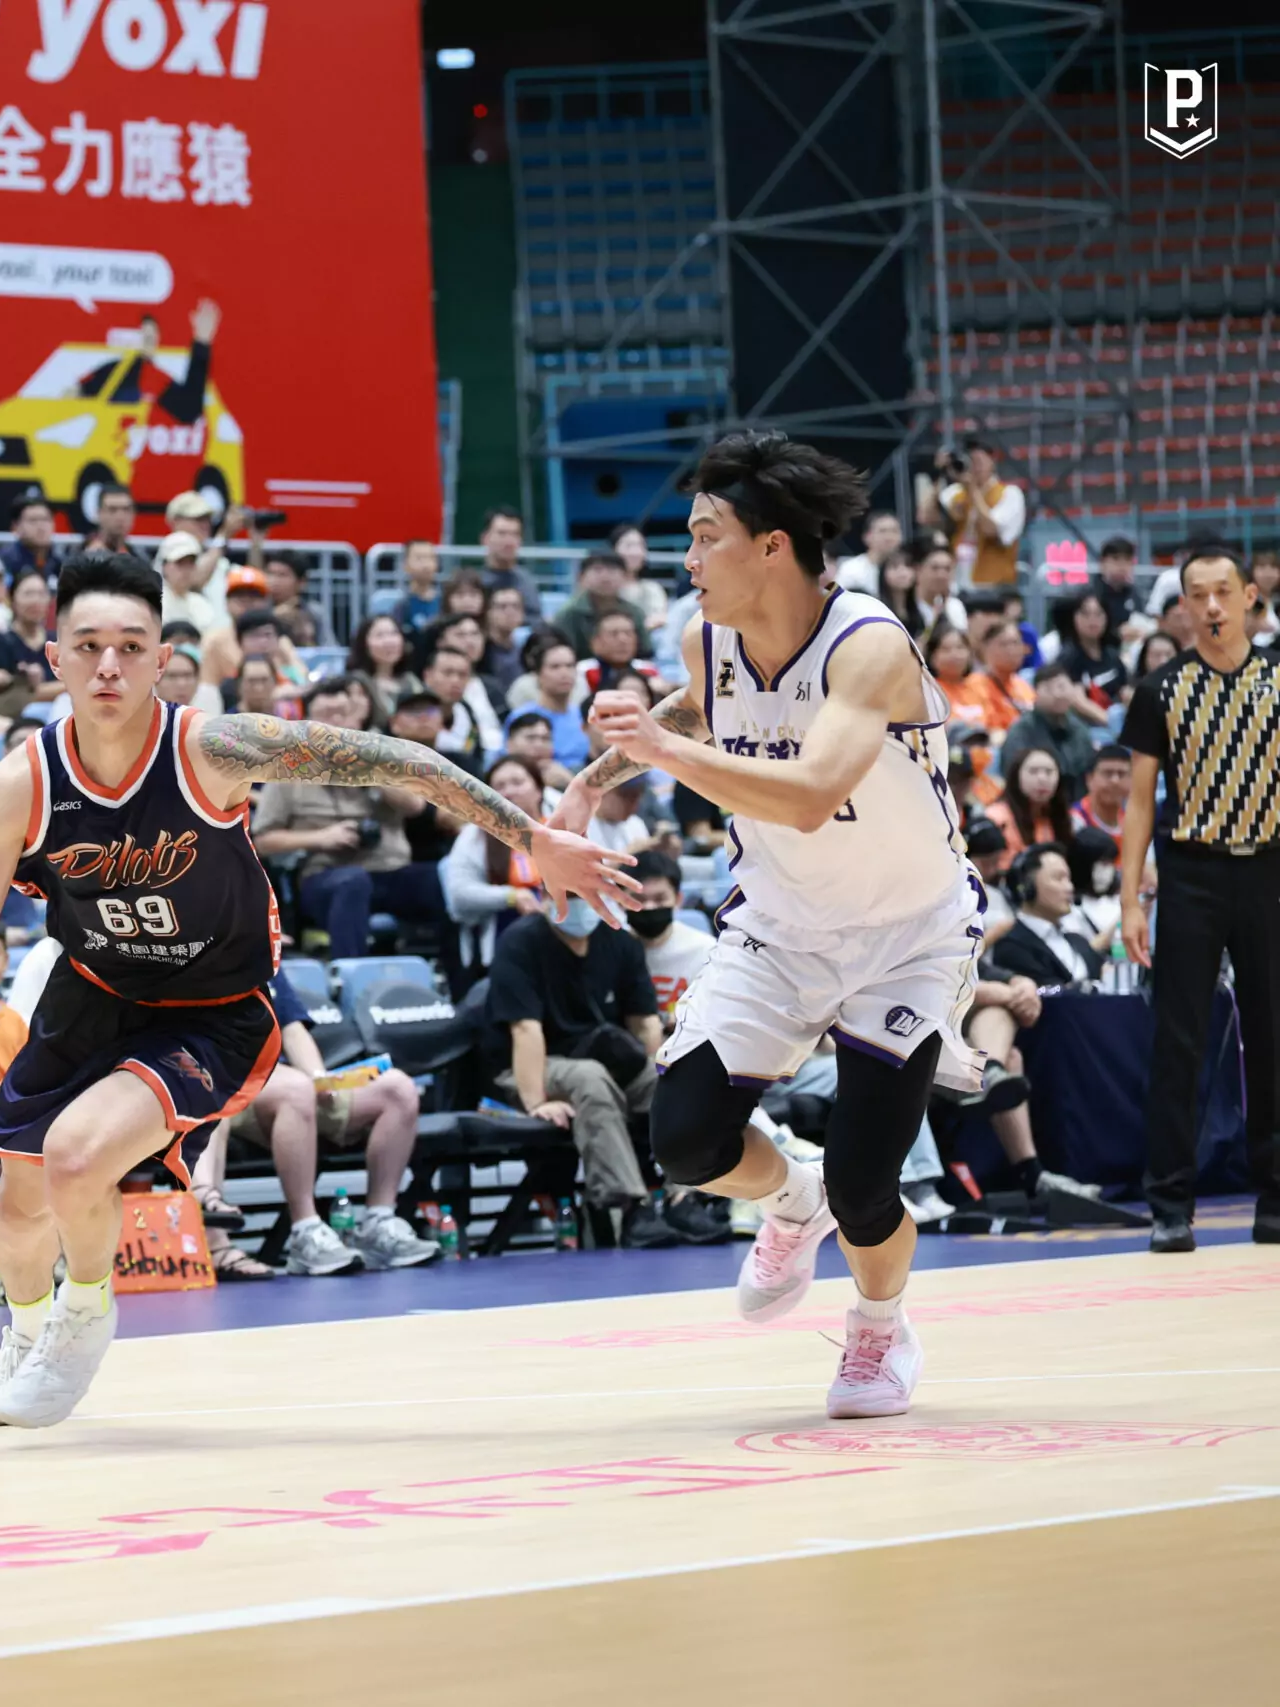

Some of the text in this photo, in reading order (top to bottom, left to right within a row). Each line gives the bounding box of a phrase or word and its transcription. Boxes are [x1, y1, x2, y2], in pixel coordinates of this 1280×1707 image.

[26, 0, 267, 82] yoxi
[125, 416, 206, 461] yoxi
[46, 829, 199, 890] Pilots
[96, 895, 180, 937] 69
[369, 1000, 456, 1025] Panasonic
